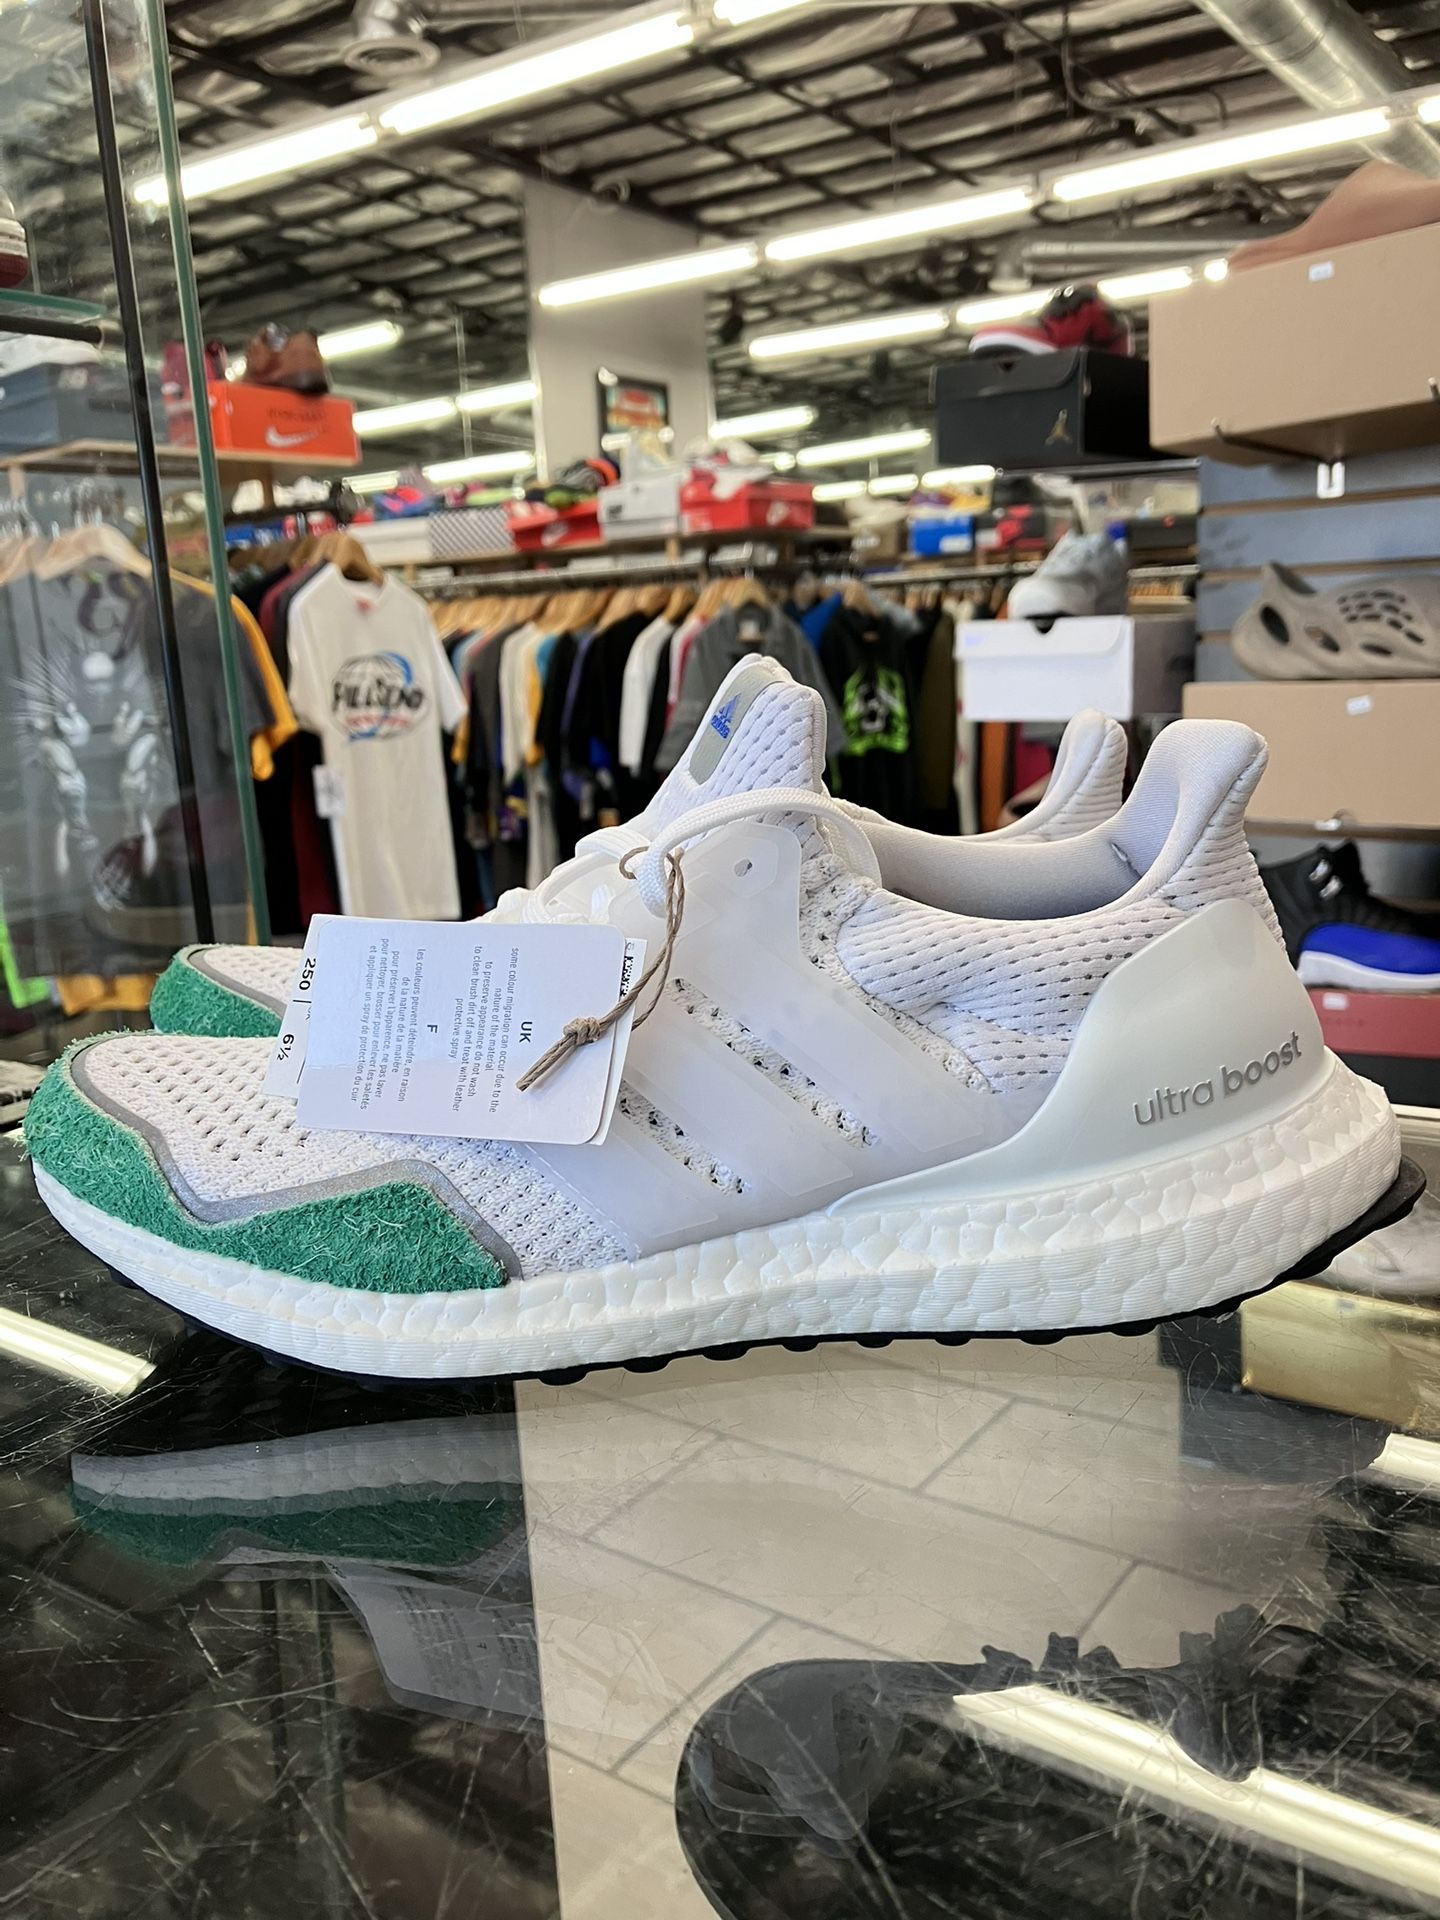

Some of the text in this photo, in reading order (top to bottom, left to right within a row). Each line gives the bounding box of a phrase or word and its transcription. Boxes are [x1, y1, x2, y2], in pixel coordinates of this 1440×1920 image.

[378, 938, 389, 956] pour
[390, 950, 399, 968] pour
[415, 948, 426, 961] les
[299, 958, 316, 990] 250
[386, 969, 399, 1005] préserver
[412, 961, 423, 995] couleurs
[374, 991, 385, 1020] brosser
[406, 996, 419, 1027] peuvent
[350, 945, 377, 1102] et appliquer un spray de protection du cuir
[370, 1020, 381, 1039] pour
[391, 976, 411, 1073] de la nature de la matière
[427, 1024, 437, 1034] F
[447, 998, 463, 1059] protective spray
[452, 945, 482, 1112] to clean brush dirt off and treat with leather
[467, 961, 493, 1097] to preserve appearance do not wash
[484, 987, 502, 1071] nature of the material
[488, 947, 519, 1113] some colour migration can occur due to the
[519, 1021, 533, 1043] UK
[368, 1039, 379, 1069] enlever
[380, 1052, 389, 1064] ne
[366, 1068, 376, 1081] les
[377, 1064, 387, 1079] pas
[402, 1066, 411, 1078] en
[1133, 1031, 1302, 1126] ultra boost
[359, 1082, 372, 1110] saletés
[374, 1079, 386, 1098] laver
[397, 1078, 408, 1102] raison
